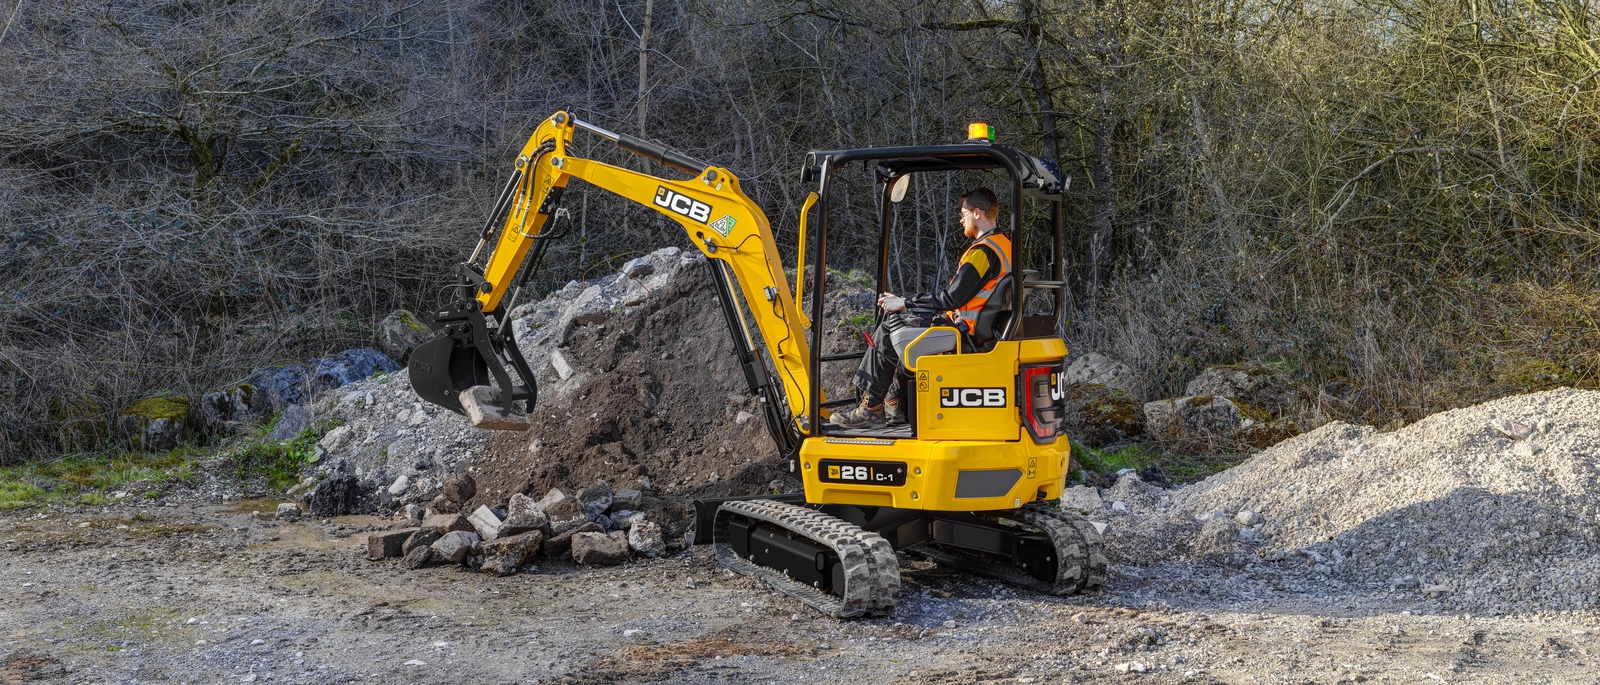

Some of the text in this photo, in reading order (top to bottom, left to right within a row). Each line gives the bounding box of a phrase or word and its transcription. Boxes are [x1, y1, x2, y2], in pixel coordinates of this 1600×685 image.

[655, 190, 710, 223] JCB
[941, 388, 1006, 407] JCB
[841, 465, 868, 481] 26
[876, 473, 894, 482] C-1
